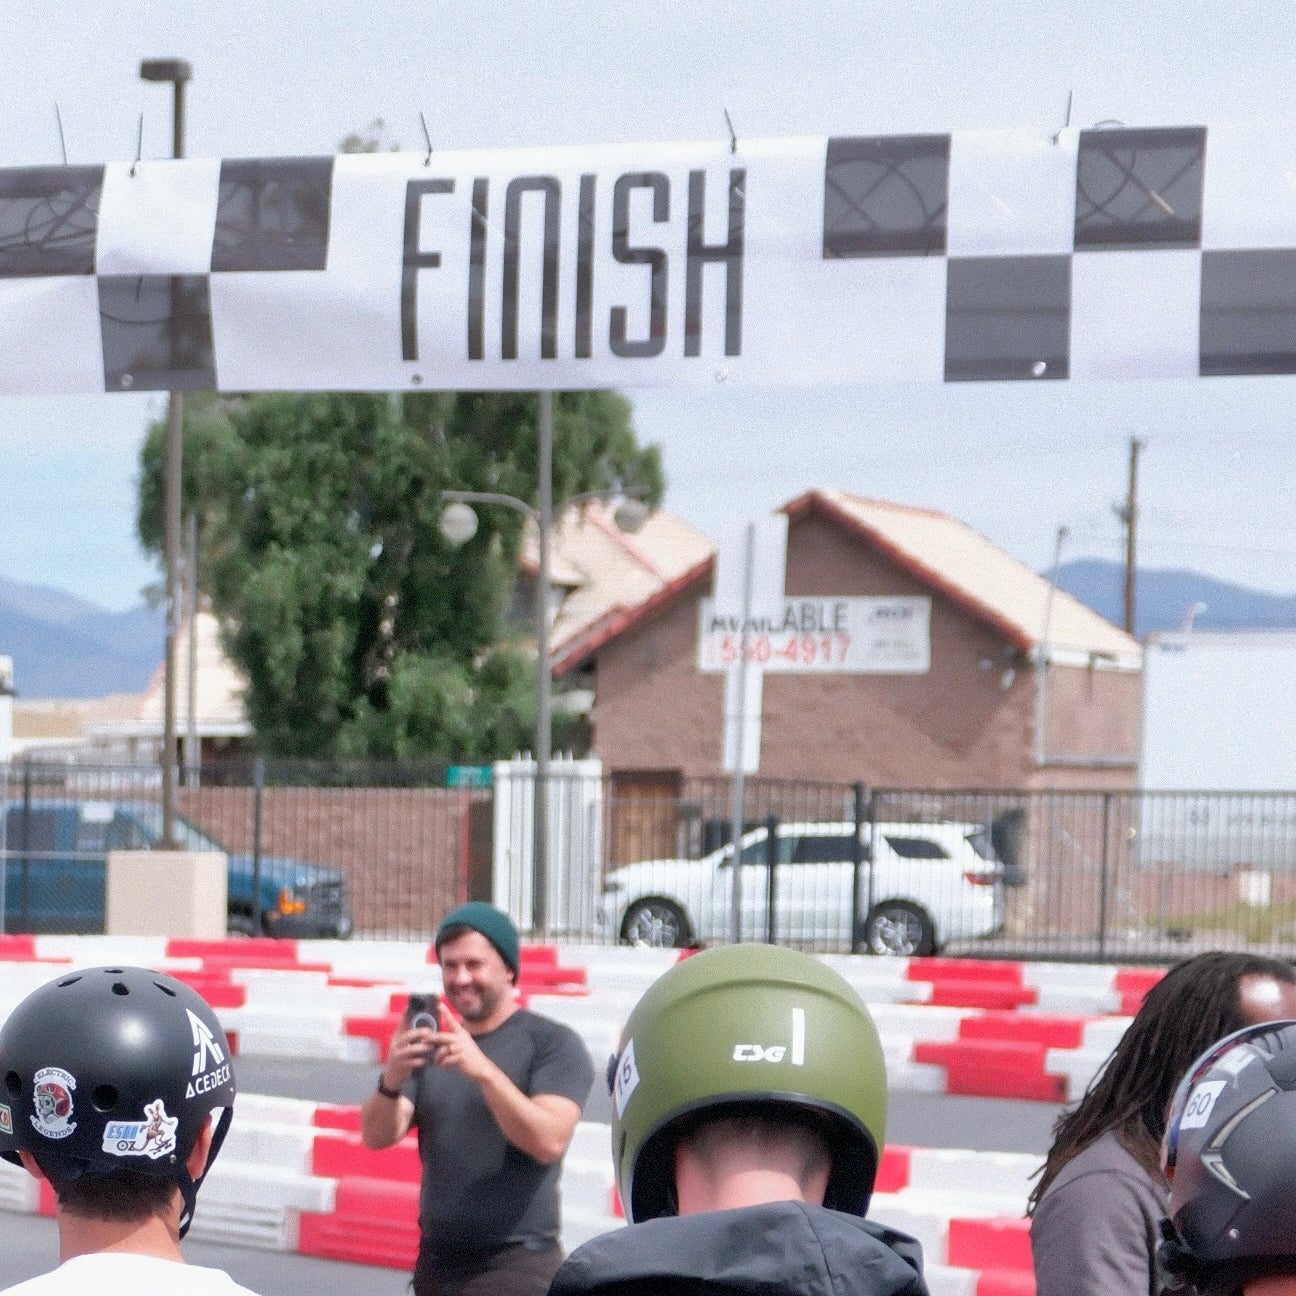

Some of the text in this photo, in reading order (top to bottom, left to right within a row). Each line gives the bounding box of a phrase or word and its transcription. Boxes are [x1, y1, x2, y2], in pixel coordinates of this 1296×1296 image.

[401, 168, 748, 361] FINISH
[36, 1069, 75, 1086] ELECTRIC
[185, 1063, 232, 1099] ACEDECK
[33, 1120, 73, 1138] LEGENDS
